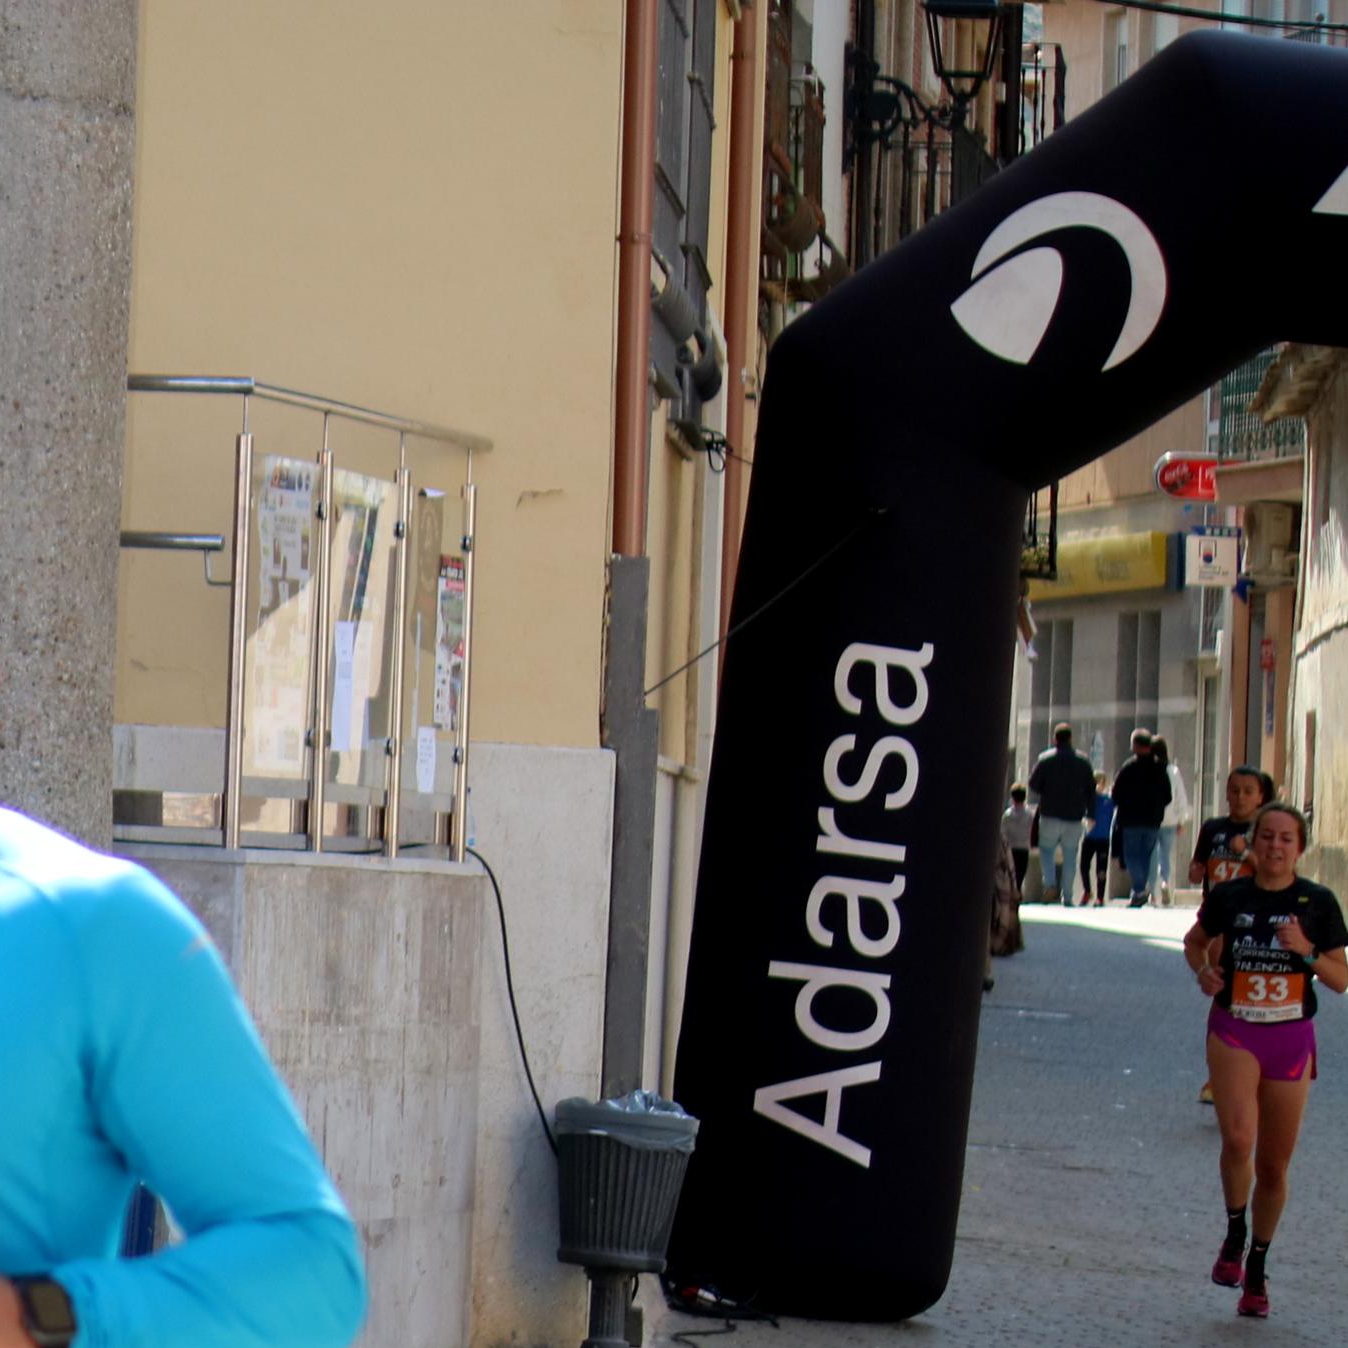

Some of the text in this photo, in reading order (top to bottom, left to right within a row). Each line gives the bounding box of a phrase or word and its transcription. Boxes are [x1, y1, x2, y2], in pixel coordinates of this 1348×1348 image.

[1214, 861, 1242, 880] 47
[753, 642, 935, 1169] Adarsa
[1247, 975, 1289, 1001] 33
